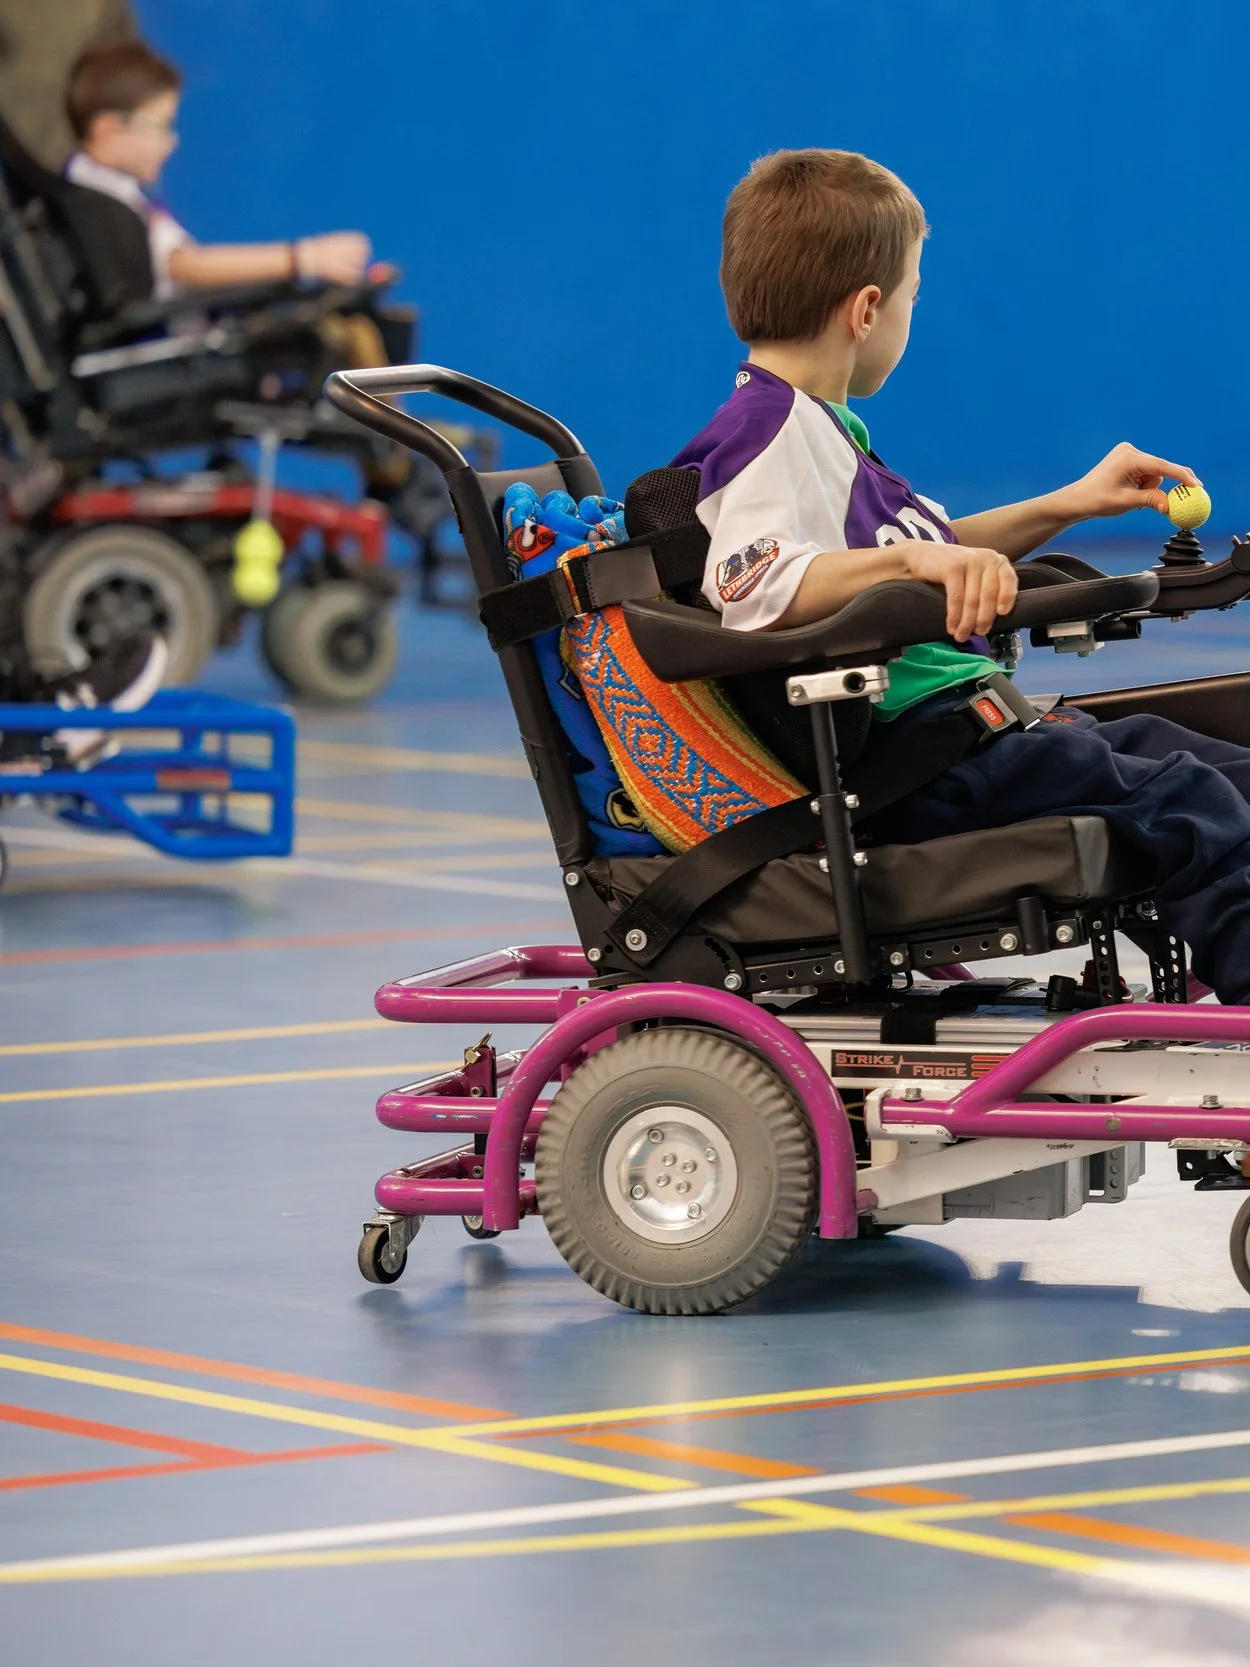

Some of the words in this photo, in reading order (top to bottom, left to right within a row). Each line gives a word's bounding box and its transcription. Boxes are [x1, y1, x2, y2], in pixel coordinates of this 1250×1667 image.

[722, 551, 777, 600] LETHBRIDGE
[982, 704, 997, 721] PRESS
[835, 1052, 894, 1065] STRIKE
[912, 1065, 967, 1077] FORCE
